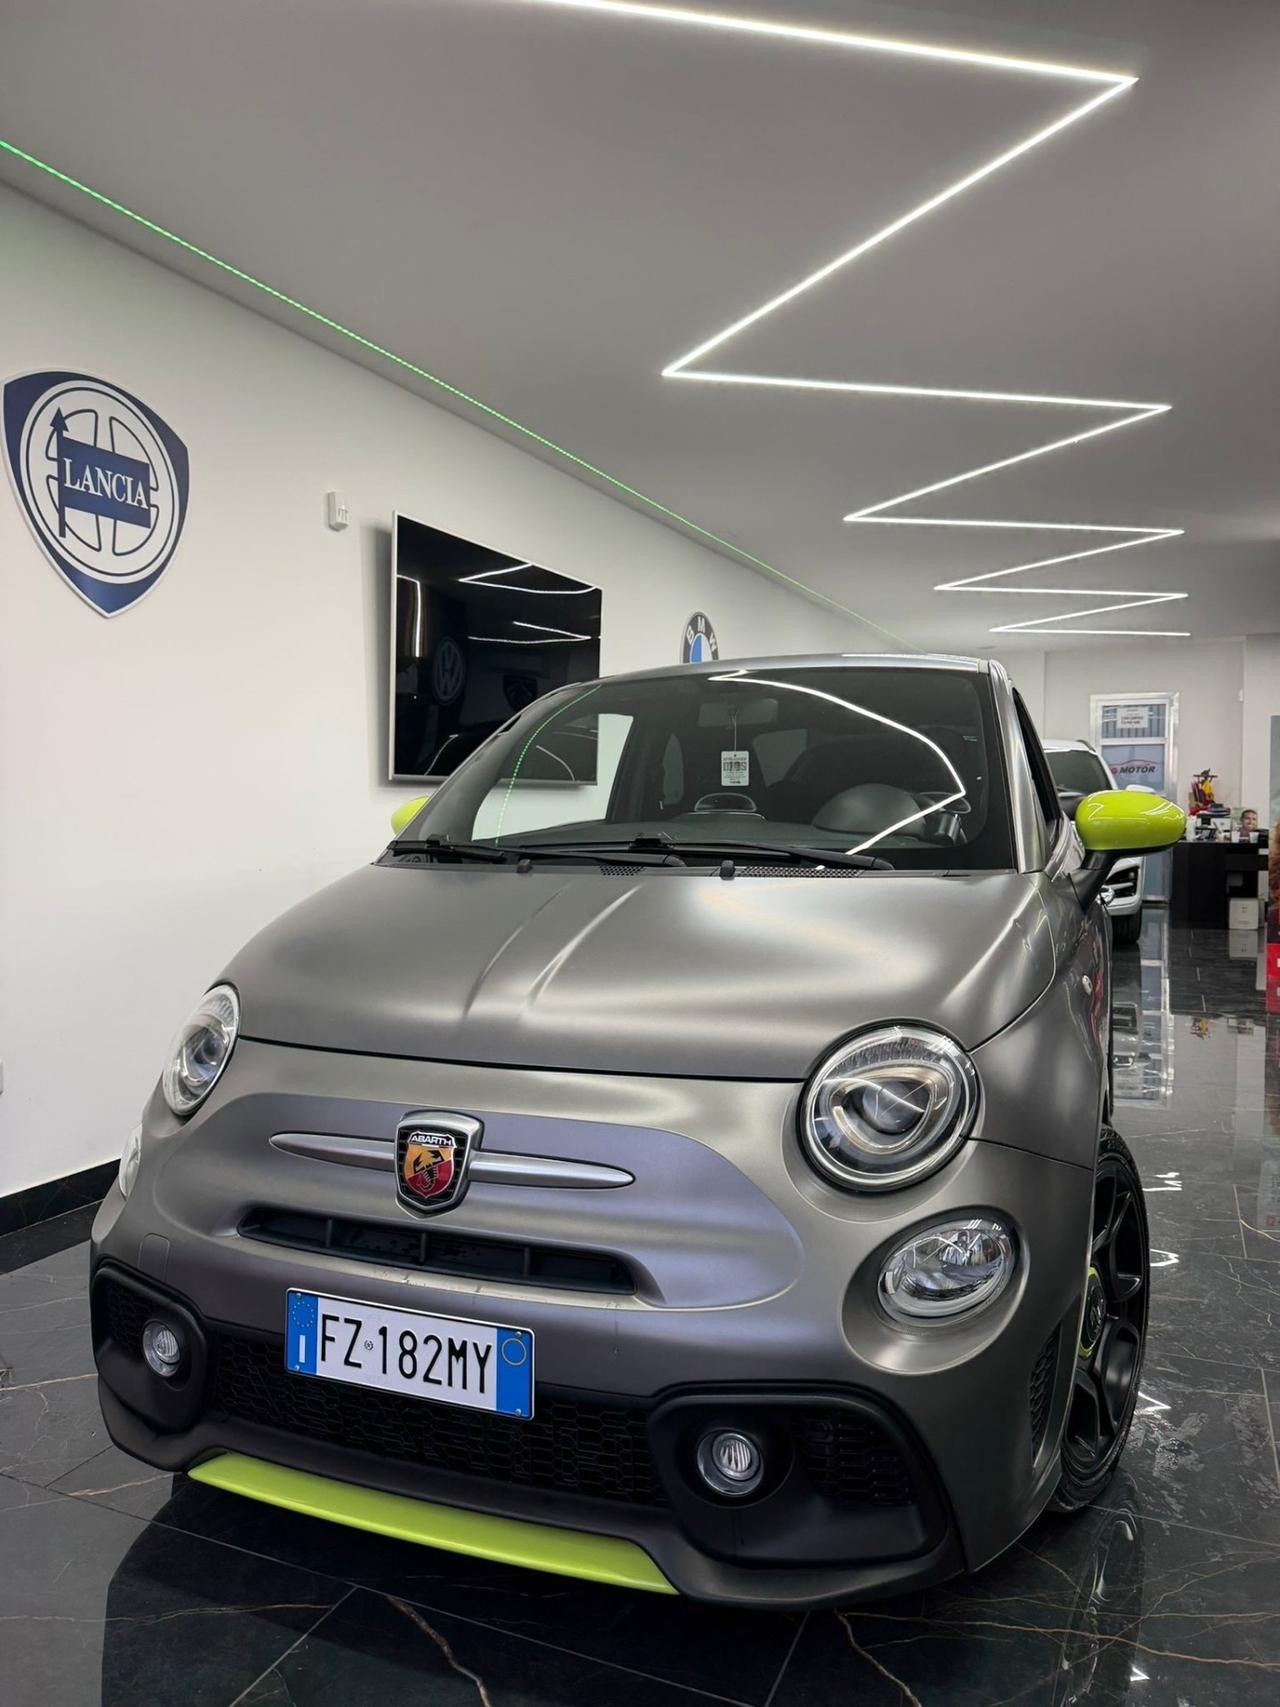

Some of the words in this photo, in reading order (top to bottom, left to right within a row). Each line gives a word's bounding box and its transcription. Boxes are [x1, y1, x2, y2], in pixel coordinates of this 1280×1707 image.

[64, 457, 149, 509] LANCIA
[686, 615, 718, 652] BMW
[1119, 766, 1156, 774] MOTOR
[411, 1135, 452, 1146] ABARTH
